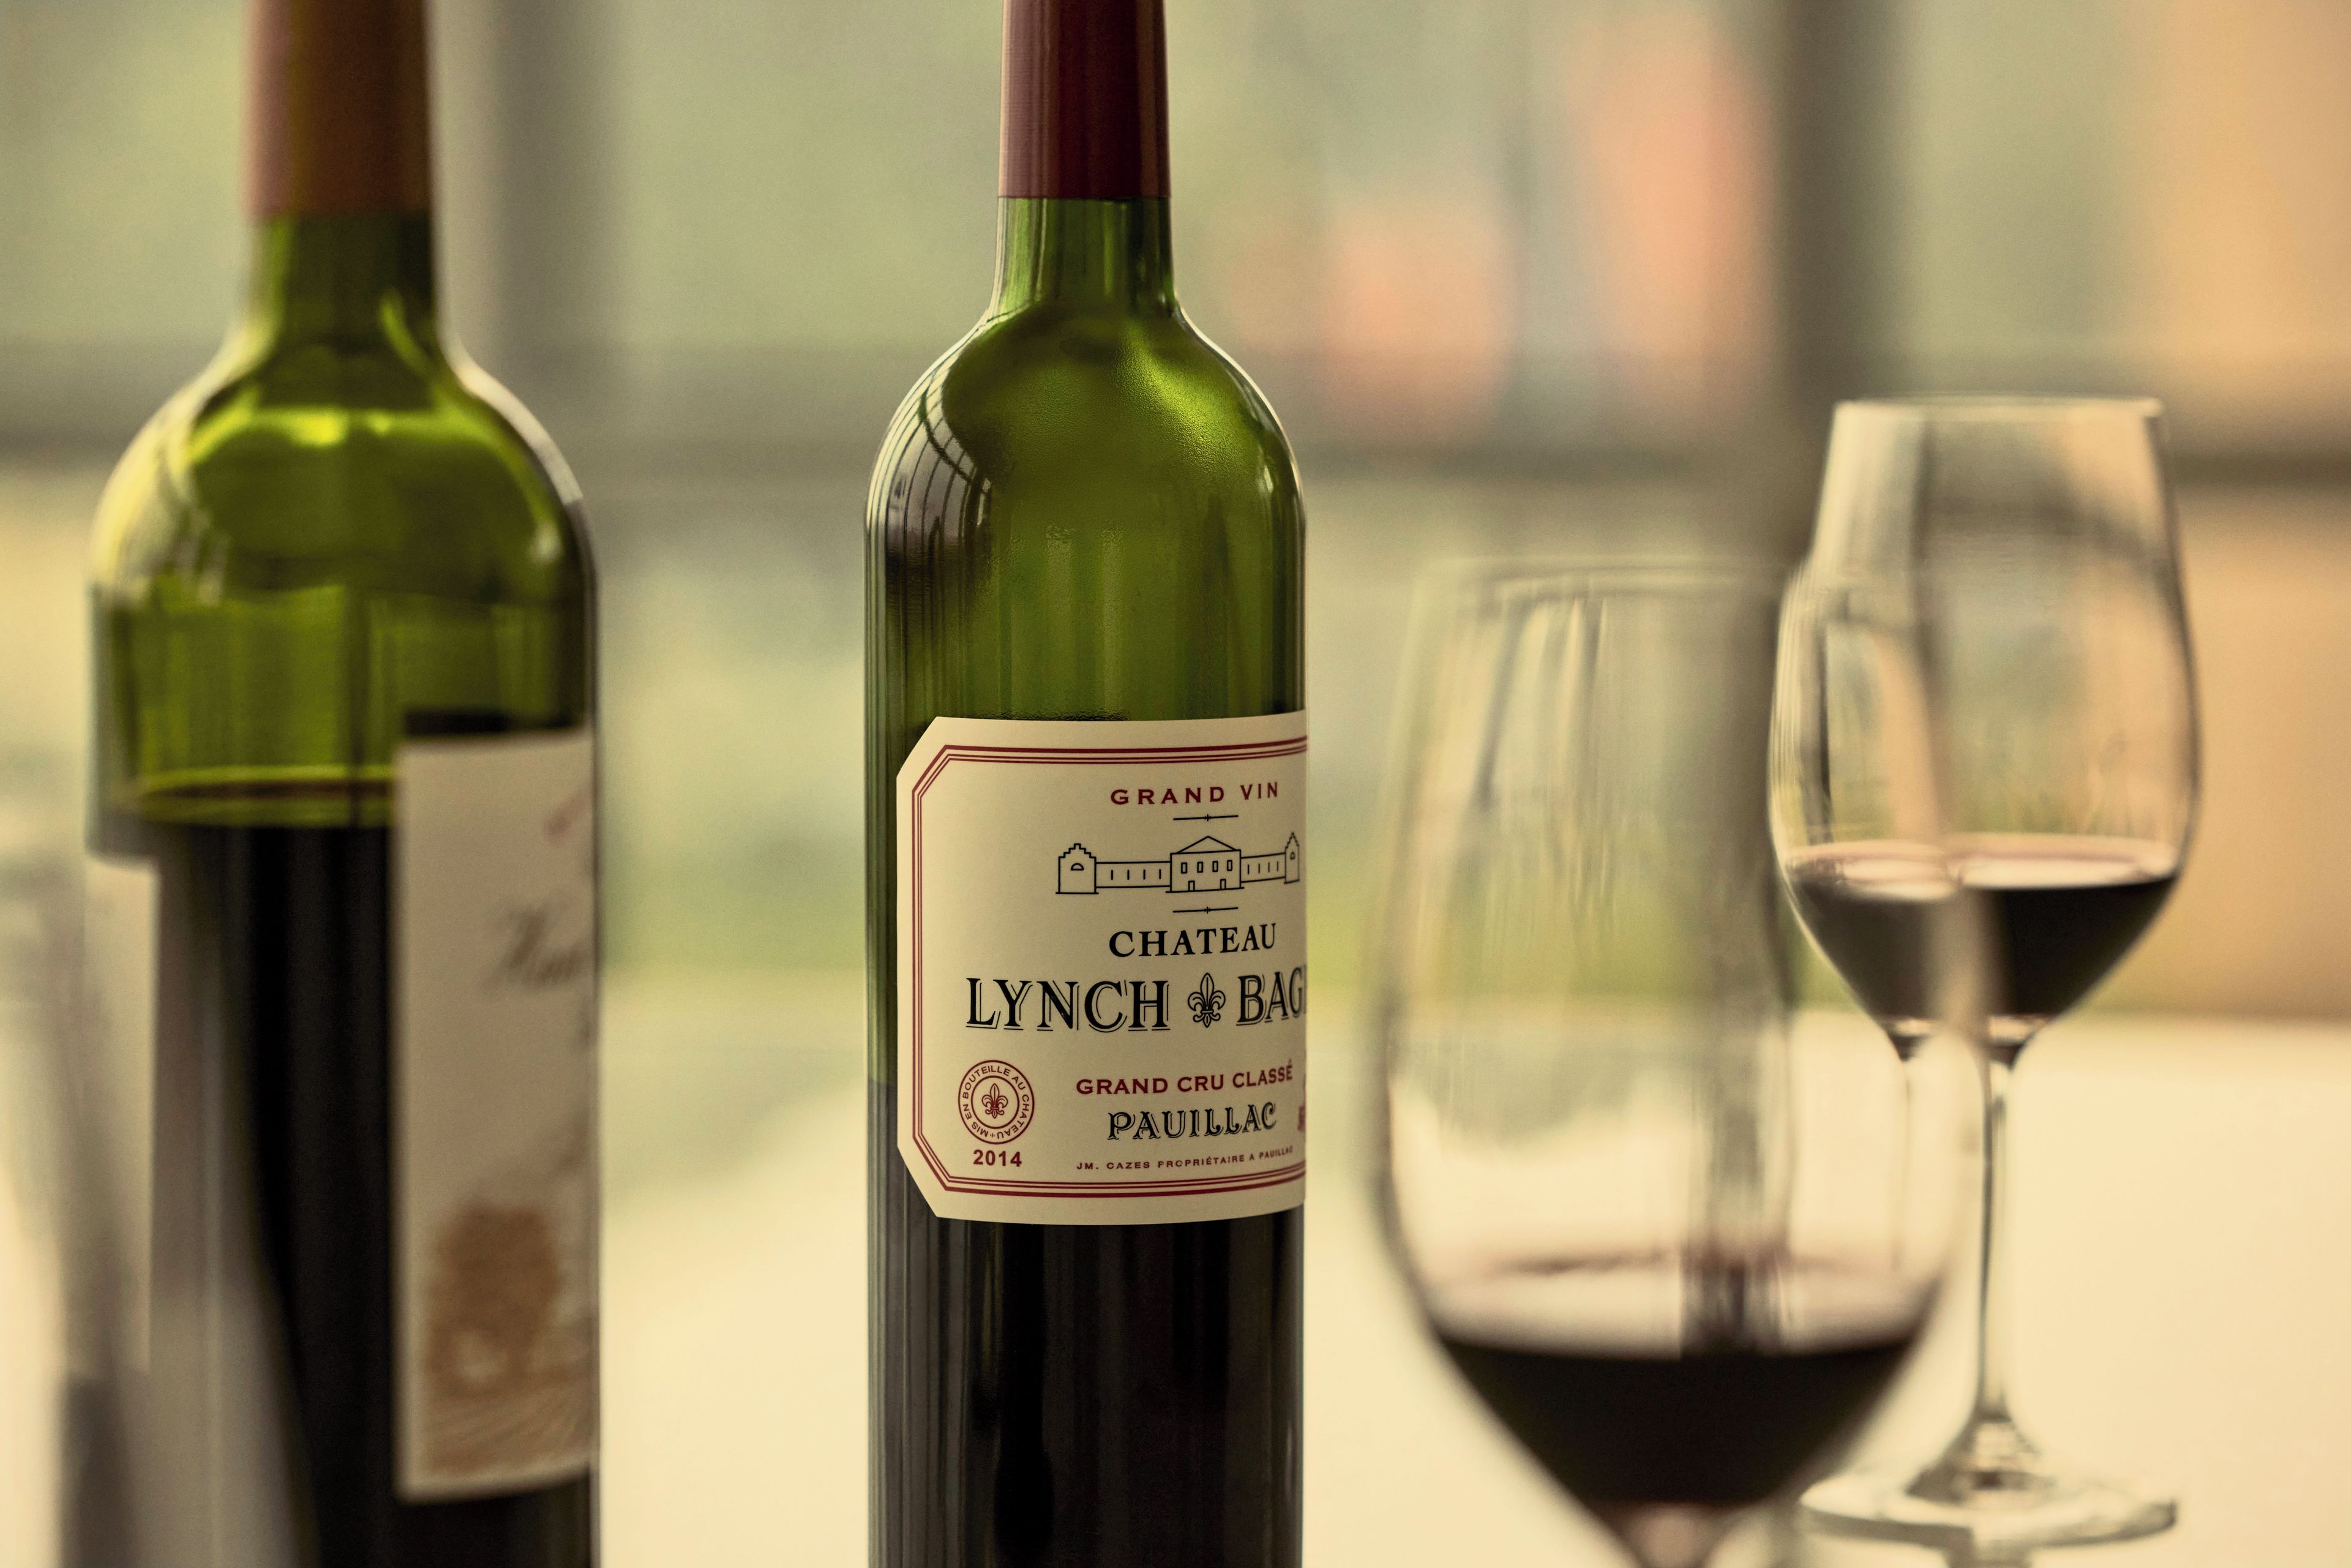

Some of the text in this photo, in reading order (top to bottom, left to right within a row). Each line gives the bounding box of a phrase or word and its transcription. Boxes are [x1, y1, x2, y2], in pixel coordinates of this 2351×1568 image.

[1110, 782, 1278, 805] GRAND VIN
[1109, 923, 1276, 958] CHATEAU
[966, 965, 1307, 1033] LYNCH BAG
[1076, 1059, 1292, 1095] GRAND CRU CLASSÉ
[962, 1065, 1030, 1139] MIS EN BOUTEILLE AU CHATEAU
[1107, 1101, 1277, 1140] PAUILLAC
[973, 1149, 1022, 1167] 2014
[1158, 1155, 1244, 1169] PROPRIÉTAIRE
[1259, 1146, 1294, 1159] PAUILLAC
